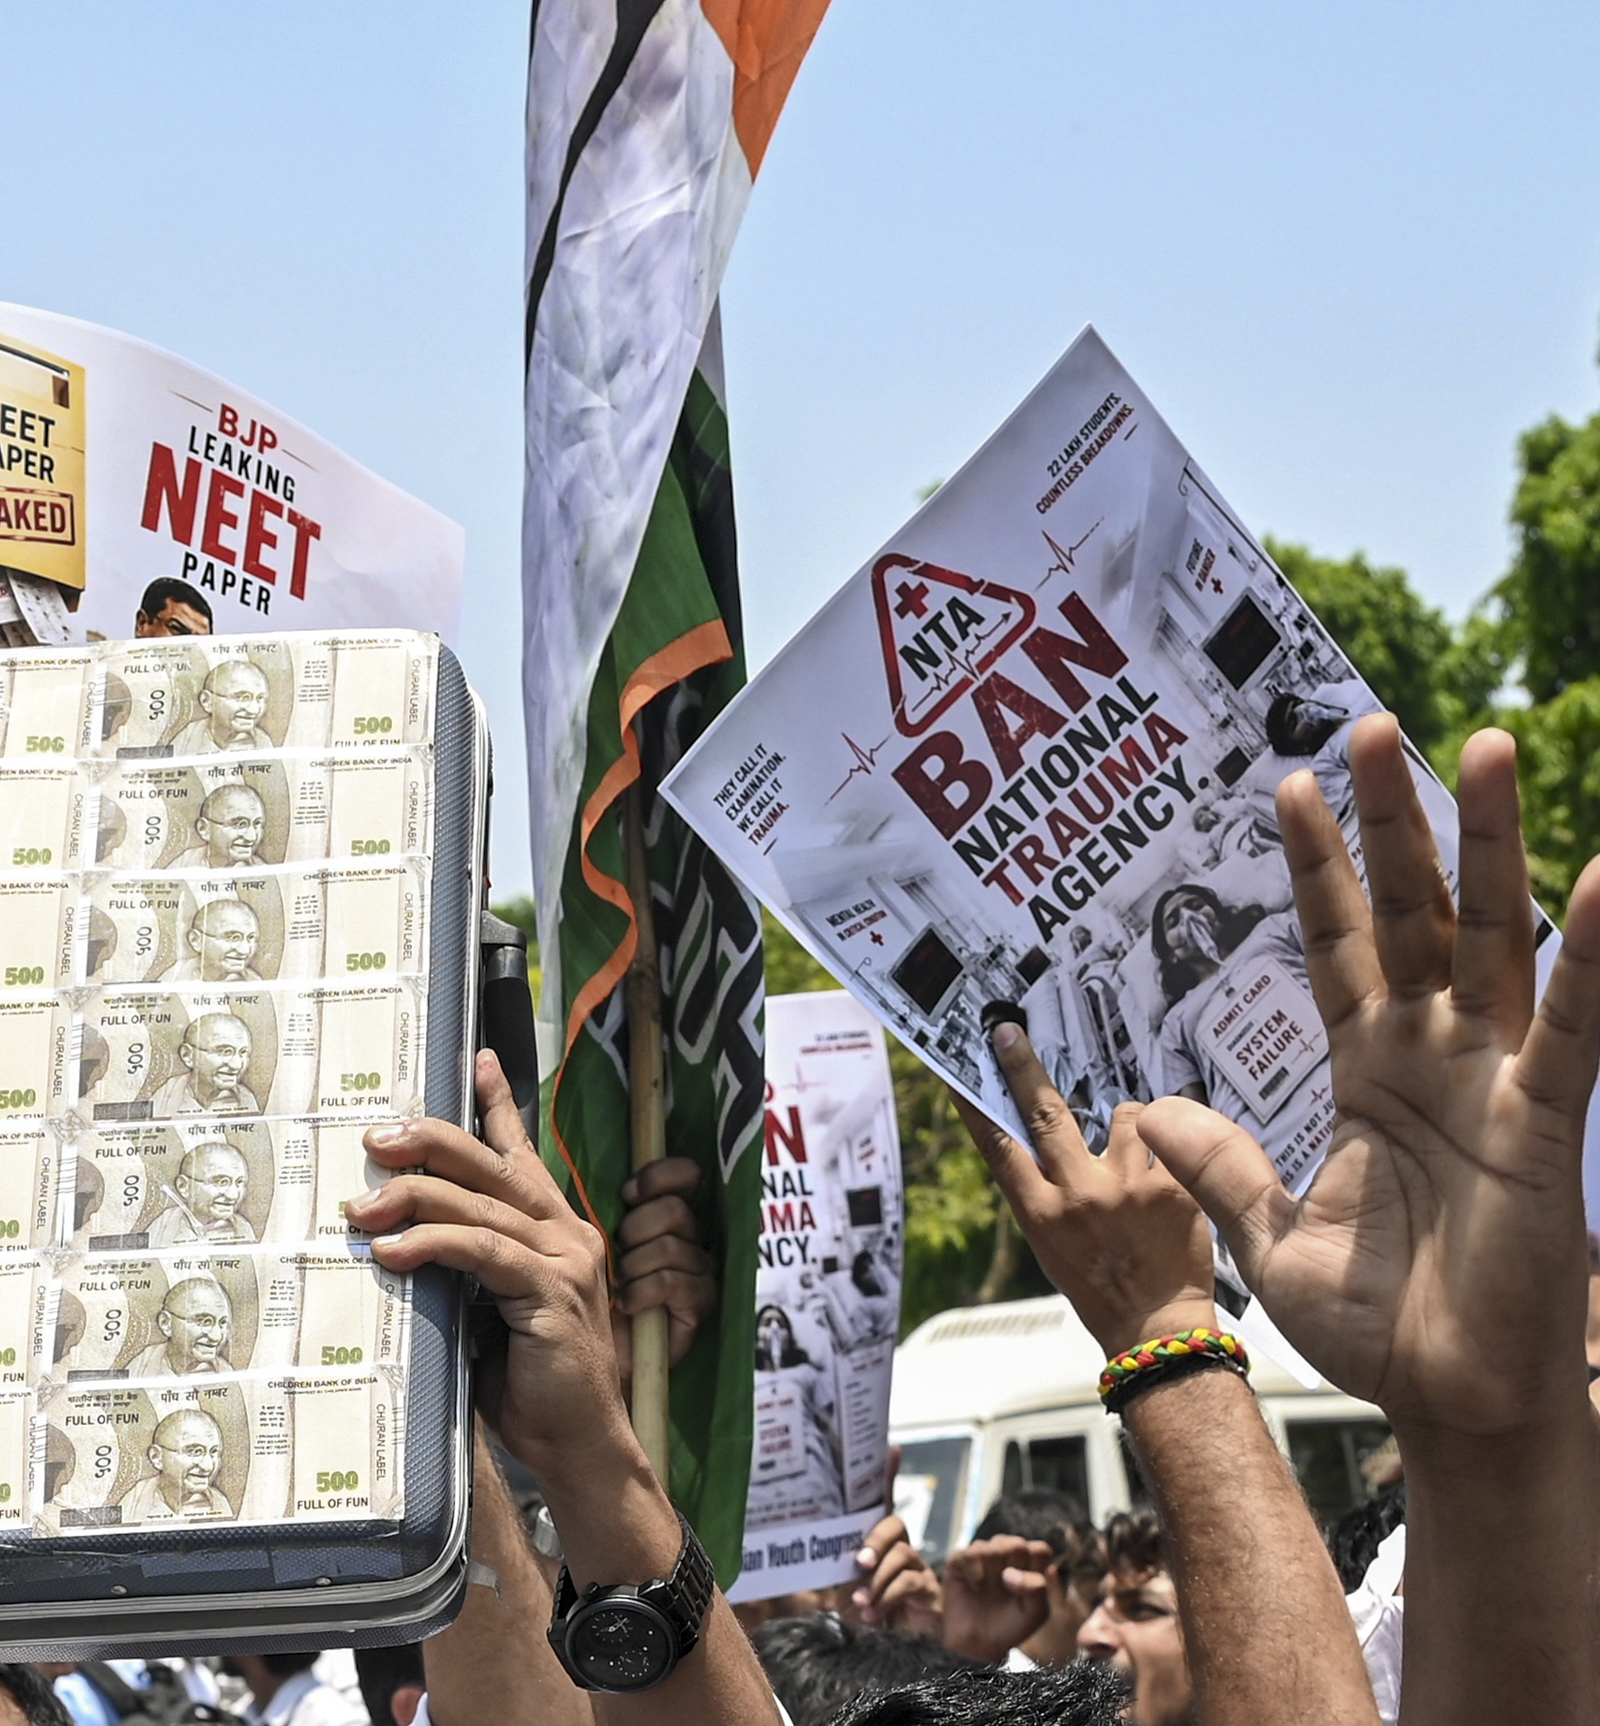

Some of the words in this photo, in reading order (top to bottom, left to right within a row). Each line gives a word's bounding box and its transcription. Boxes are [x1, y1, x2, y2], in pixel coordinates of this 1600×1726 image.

[218, 402, 278, 455] BJP
[1047, 460, 1062, 478] 22
[1058, 436, 1083, 464] LAKH
[1079, 392, 1122, 440] STUDENTS.
[187, 425, 296, 503] LEAKING
[1036, 461, 1084, 514] COUNTLESS
[1080, 403, 1134, 466] BREAKDOWNS.
[140, 441, 321, 601] NEET
[181, 551, 271, 615] PAPER
[899, 596, 986, 681] NTA
[353, 717, 392, 734] 500
[891, 591, 1129, 841] BAN
[26, 736, 64, 753] 500
[713, 778, 737, 807] THEY
[734, 756, 759, 783] CALL
[754, 743, 767, 759] IT
[725, 752, 786, 821] EXAMINATION.
[952, 675, 1159, 877] NATIONAL
[737, 813, 754, 833] WE
[750, 791, 775, 818] CALL
[770, 777, 783, 793] IT
[748, 802, 790, 845] TRAUMA.
[982, 712, 1189, 907] TRAUMA
[13, 849, 51, 865] 500
[351, 840, 390, 855] 500
[1027, 754, 1209, 944] AGENCY.
[826, 909, 856, 927] MENTAL
[852, 899, 876, 914] HEALTH
[5, 967, 44, 985] 500
[346, 952, 386, 970] 500
[101, 1014, 128, 1025] FULL
[132, 1014, 145, 1024] OF
[149, 1014, 171, 1023] FUN
[1212, 1003, 1244, 1039] ADMIT
[1243, 974, 1271, 1004] CARD
[1236, 1009, 1288, 1065] SYSTEM
[1248, 1021, 1303, 1081] FAILURE
[340, 1073, 380, 1091] 500
[1275, 1144, 1295, 1167] THIS
[1294, 1132, 1305, 1145] IS
[1304, 1112, 1322, 1134] NOT
[1323, 1099, 1334, 1115] JU
[1292, 1158, 1303, 1172] IS
[1302, 1150, 1310, 1160] A
[321, 1346, 362, 1365] 500
[204, 1387, 228, 1399] नम्बर
[268, 1381, 311, 1389] CHILDREN
[314, 1380, 337, 1388] BANK
[376, 1403, 386, 1446] CHURAN
[316, 1471, 358, 1491] 500
[376, 1449, 386, 1481] LABEL
[297, 1499, 323, 1509] FULL
[328, 1498, 341, 1508] OF
[345, 1497, 368, 1507] FUN
[767, 1537, 805, 1568] Youth
